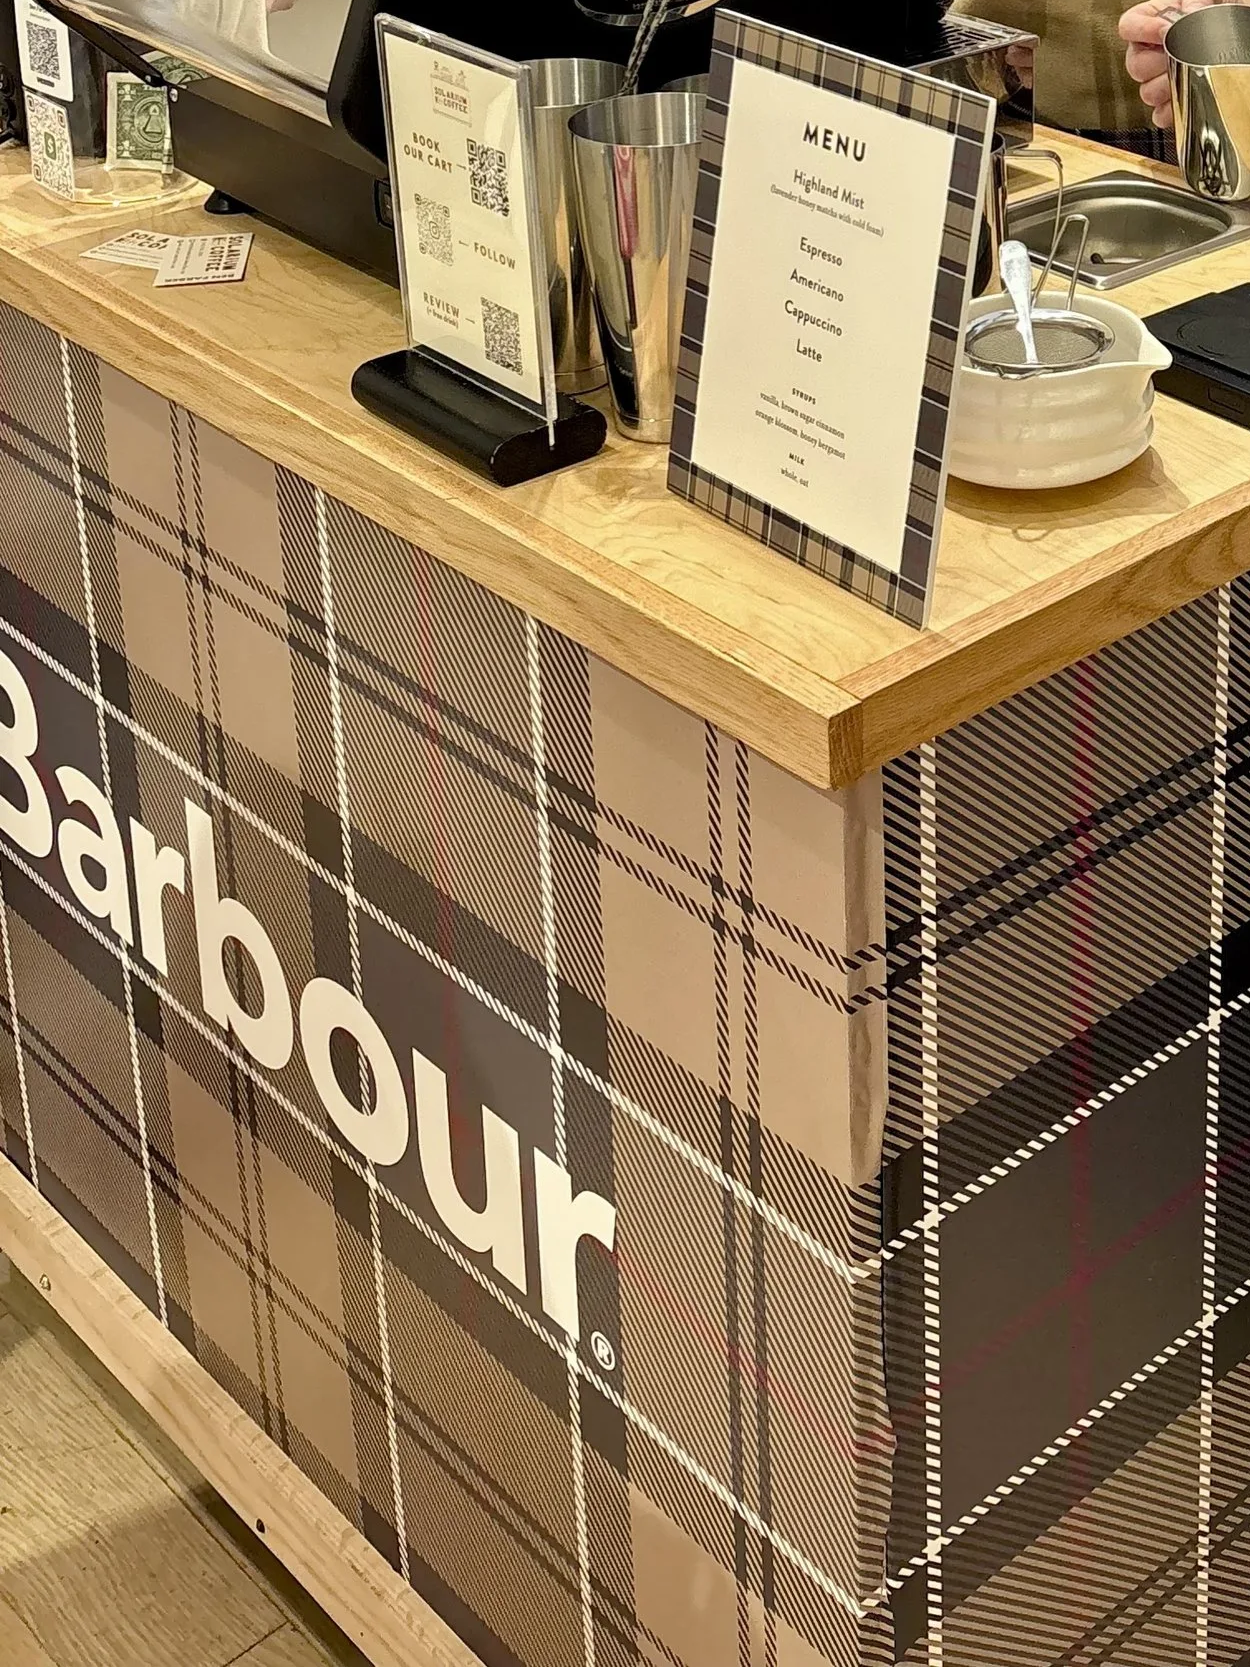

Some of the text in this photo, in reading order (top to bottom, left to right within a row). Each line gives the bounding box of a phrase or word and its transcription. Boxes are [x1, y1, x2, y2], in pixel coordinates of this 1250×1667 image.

[412, 132, 441, 153] BOOK
[802, 121, 867, 162] MENU
[403, 144, 453, 174] OUR CART
[793, 169, 865, 210] Highland Mist
[770, 184, 884, 238] (lavender honey matcha with cold foam)
[205, 246, 225, 272] COFFEE
[222, 235, 244, 271] SOLARIUM
[473, 241, 516, 270] FOLLOW
[799, 236, 843, 267] Espresso
[790, 268, 845, 302] Americano
[423, 291, 460, 319] REVIEW
[784, 299, 843, 337] Cappuccino
[796, 338, 823, 363] Latte
[791, 387, 816, 405] SYRUPS
[755, 409, 775, 425] orange
[781, 400, 799, 417] brown
[815, 419, 845, 439] cinnamon
[788, 452, 805, 465] MILK
